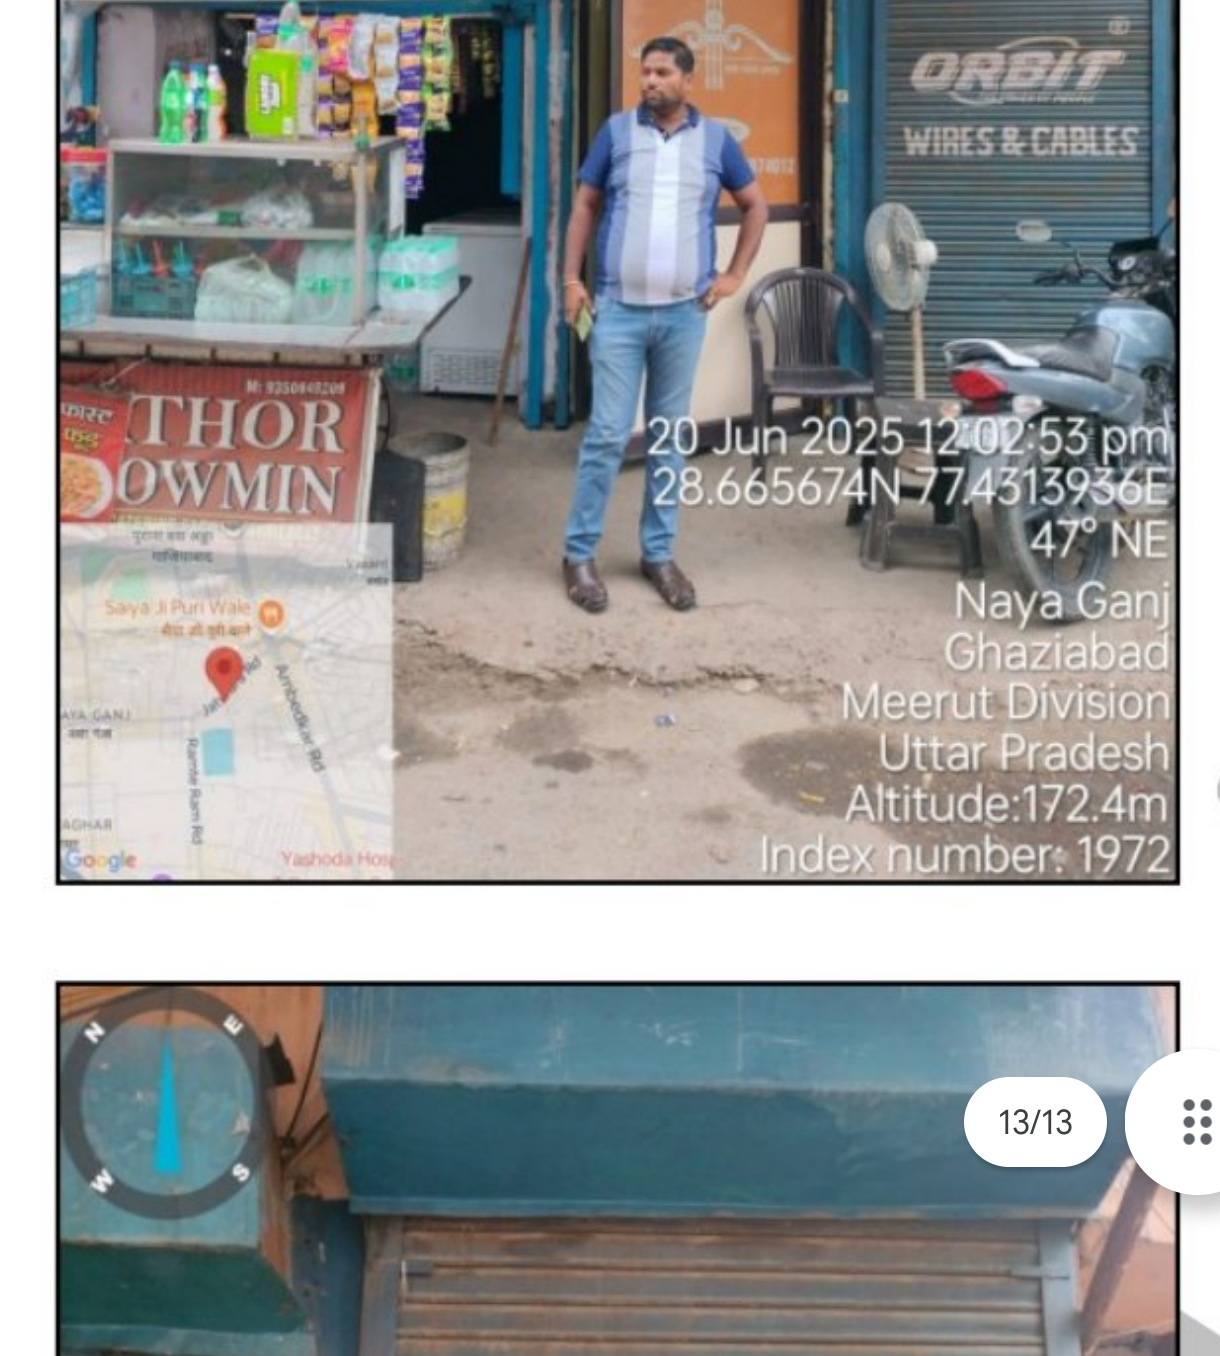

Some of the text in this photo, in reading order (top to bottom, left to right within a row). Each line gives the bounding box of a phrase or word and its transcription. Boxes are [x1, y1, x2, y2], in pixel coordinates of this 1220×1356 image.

[910, 49, 1127, 91] ORBIT
[903, 126, 1140, 157] WIRES & CABLES
[128, 392, 345, 455] THOR
[117, 457, 343, 515] OWMIN
[998, 1107, 1073, 1136] 13/13
